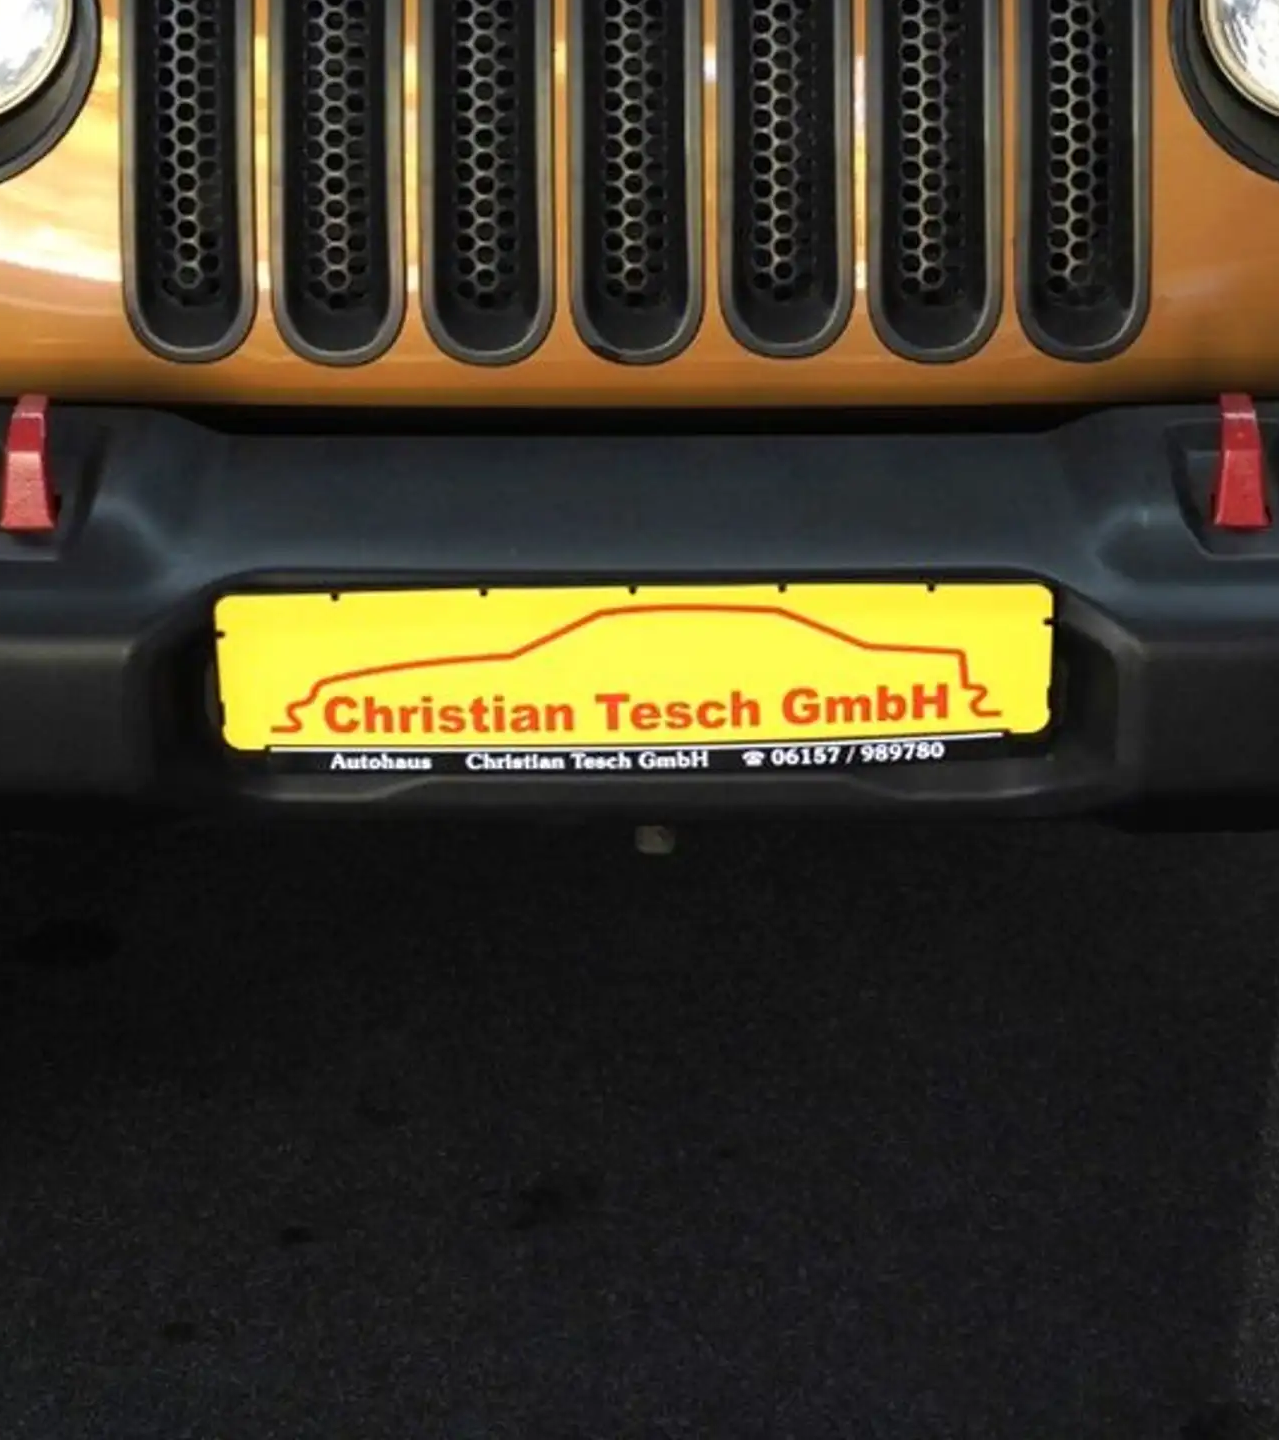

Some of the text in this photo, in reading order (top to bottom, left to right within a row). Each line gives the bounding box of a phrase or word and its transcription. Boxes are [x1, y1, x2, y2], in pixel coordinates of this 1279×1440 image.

[324, 683, 949, 733] Christian Tesch GmbH
[330, 752, 433, 770] Autohaus
[465, 752, 565, 770] Christian
[571, 751, 632, 770] Tesch
[638, 750, 709, 769] GmbH
